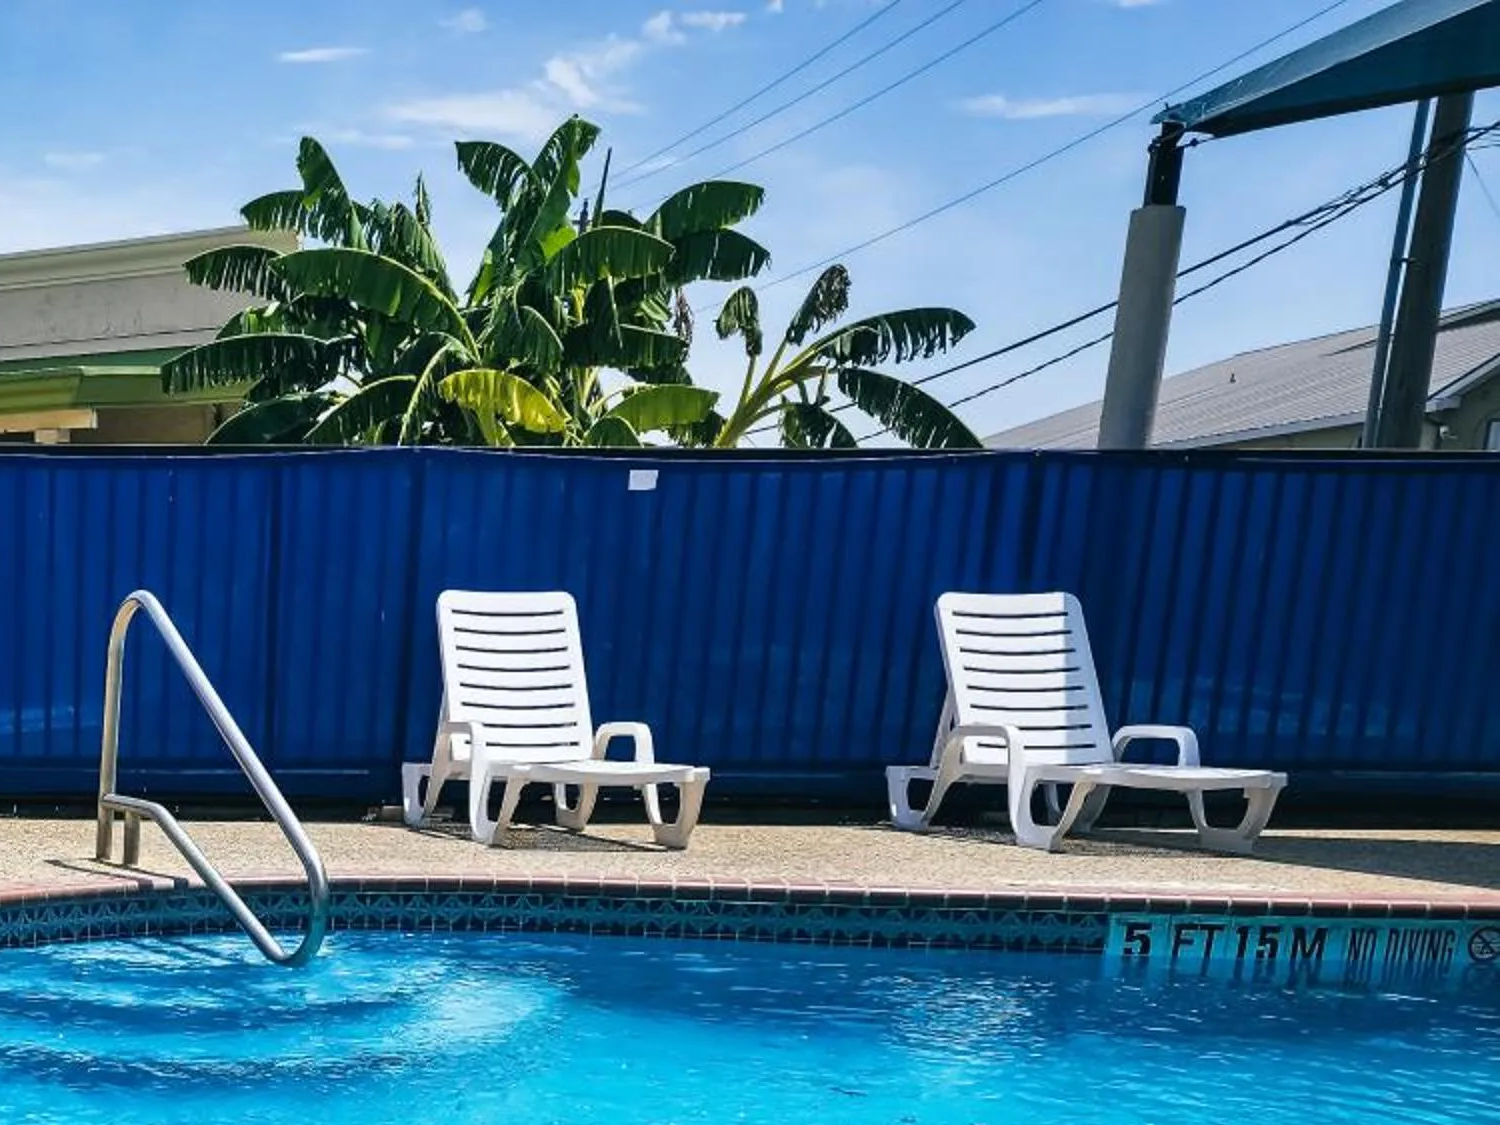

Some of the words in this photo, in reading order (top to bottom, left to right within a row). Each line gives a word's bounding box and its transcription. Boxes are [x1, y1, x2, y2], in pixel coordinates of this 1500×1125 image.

[1123, 922, 1151, 956] 5
[1171, 923, 1226, 961] FT
[1349, 927, 1377, 962] NO
[1384, 927, 1456, 962] DIVING
